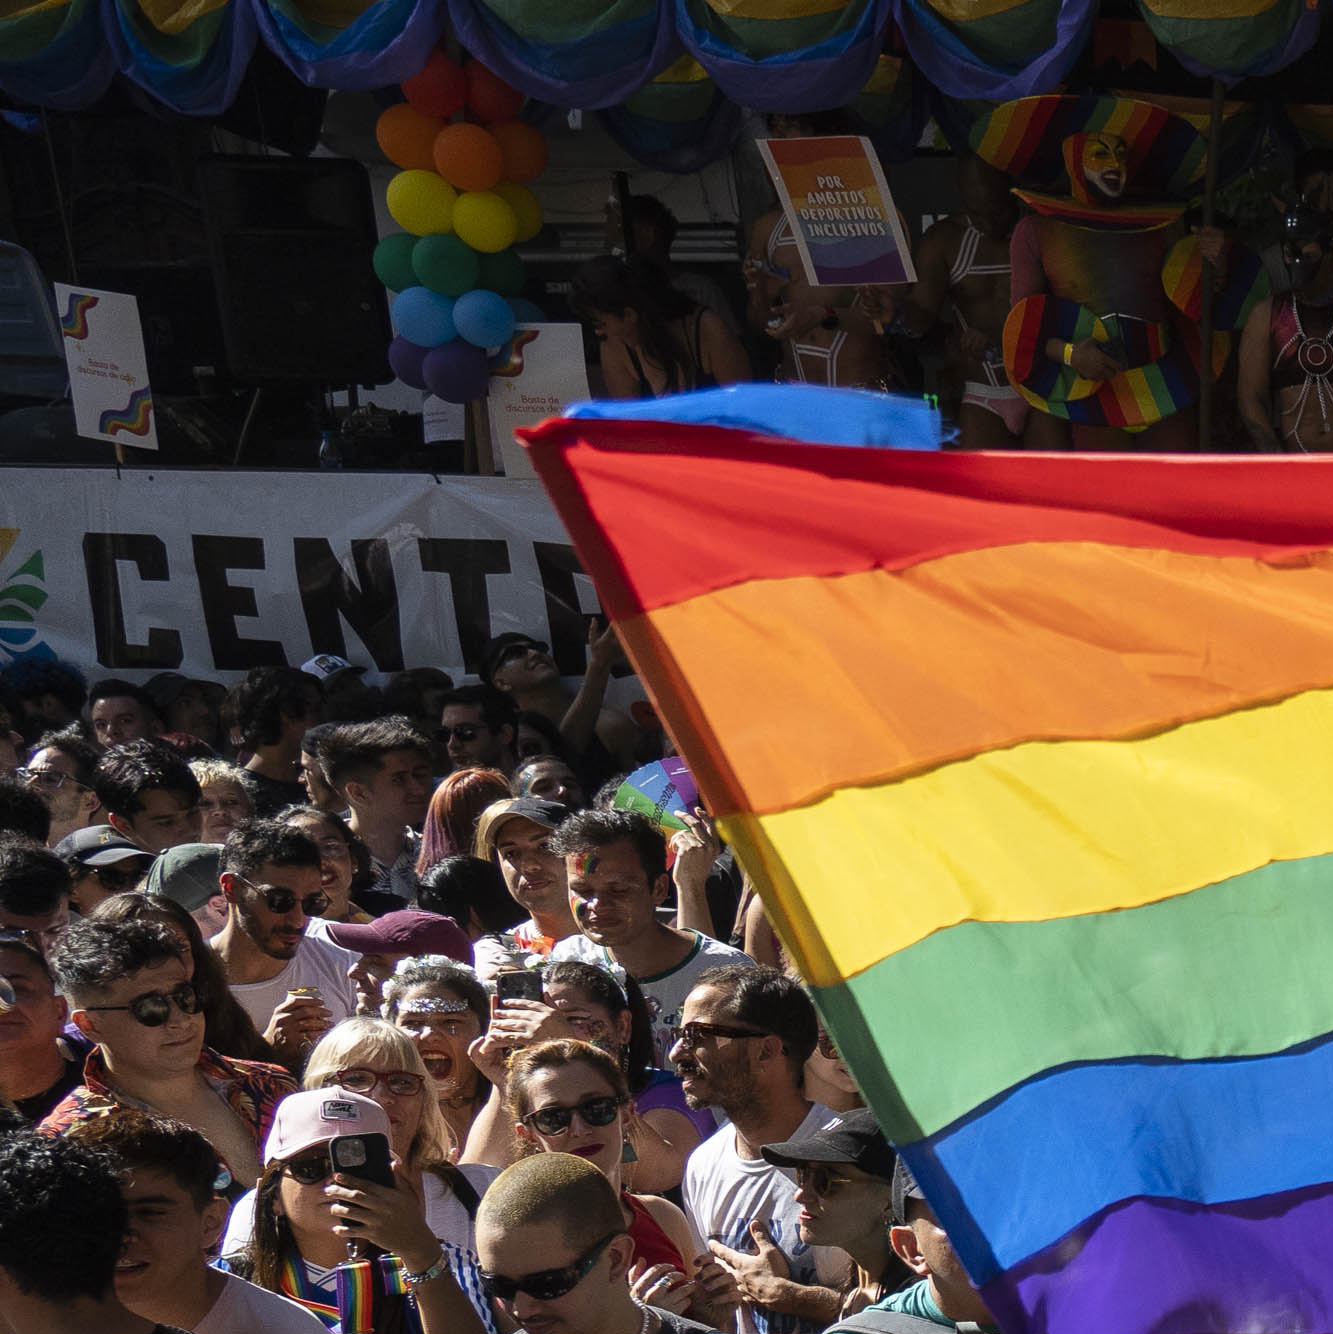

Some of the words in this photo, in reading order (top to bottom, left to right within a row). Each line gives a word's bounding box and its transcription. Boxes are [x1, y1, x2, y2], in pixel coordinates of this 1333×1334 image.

[816, 176, 844, 190] POR
[807, 190, 868, 205] AMBITOS
[800, 206, 882, 221] DEPORTIVOS
[807, 221, 886, 237] INCLUSIVOS
[521, 394, 546, 404] Basta
[505, 404, 546, 414] discursos
[83, 532, 637, 678] CENTR
